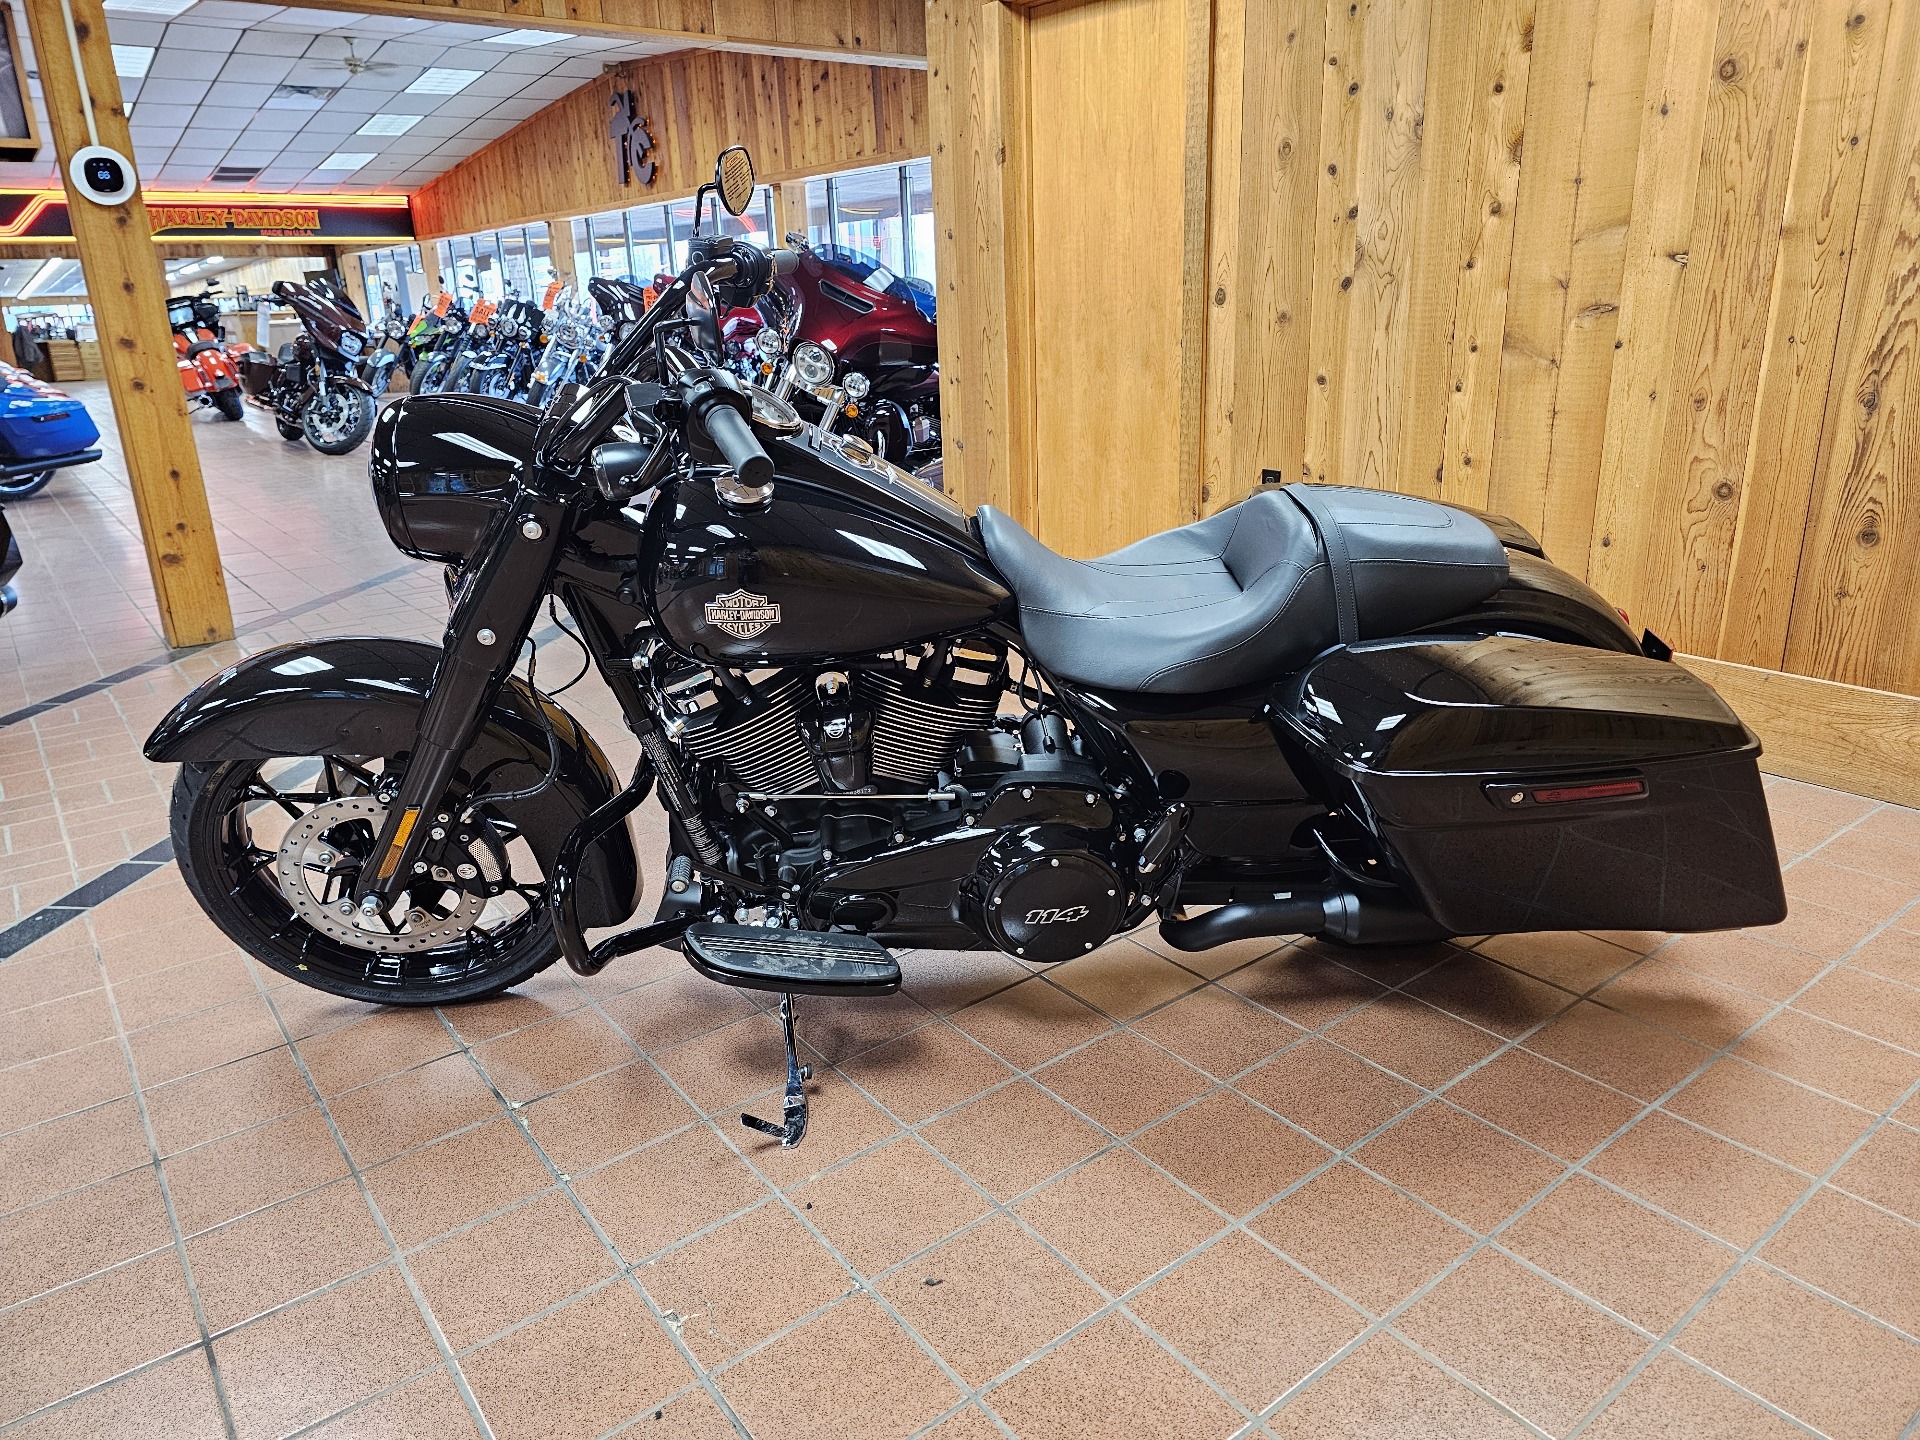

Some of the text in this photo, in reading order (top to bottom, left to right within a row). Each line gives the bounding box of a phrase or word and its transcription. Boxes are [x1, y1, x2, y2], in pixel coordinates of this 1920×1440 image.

[147, 208, 320, 232] HARLEY-DAVIDSON
[725, 596, 759, 607] MOTOR
[710, 609, 775, 620] HARLEY-DAVIDSON
[726, 622, 760, 634] CYCLES
[1024, 905, 1090, 924] 114
